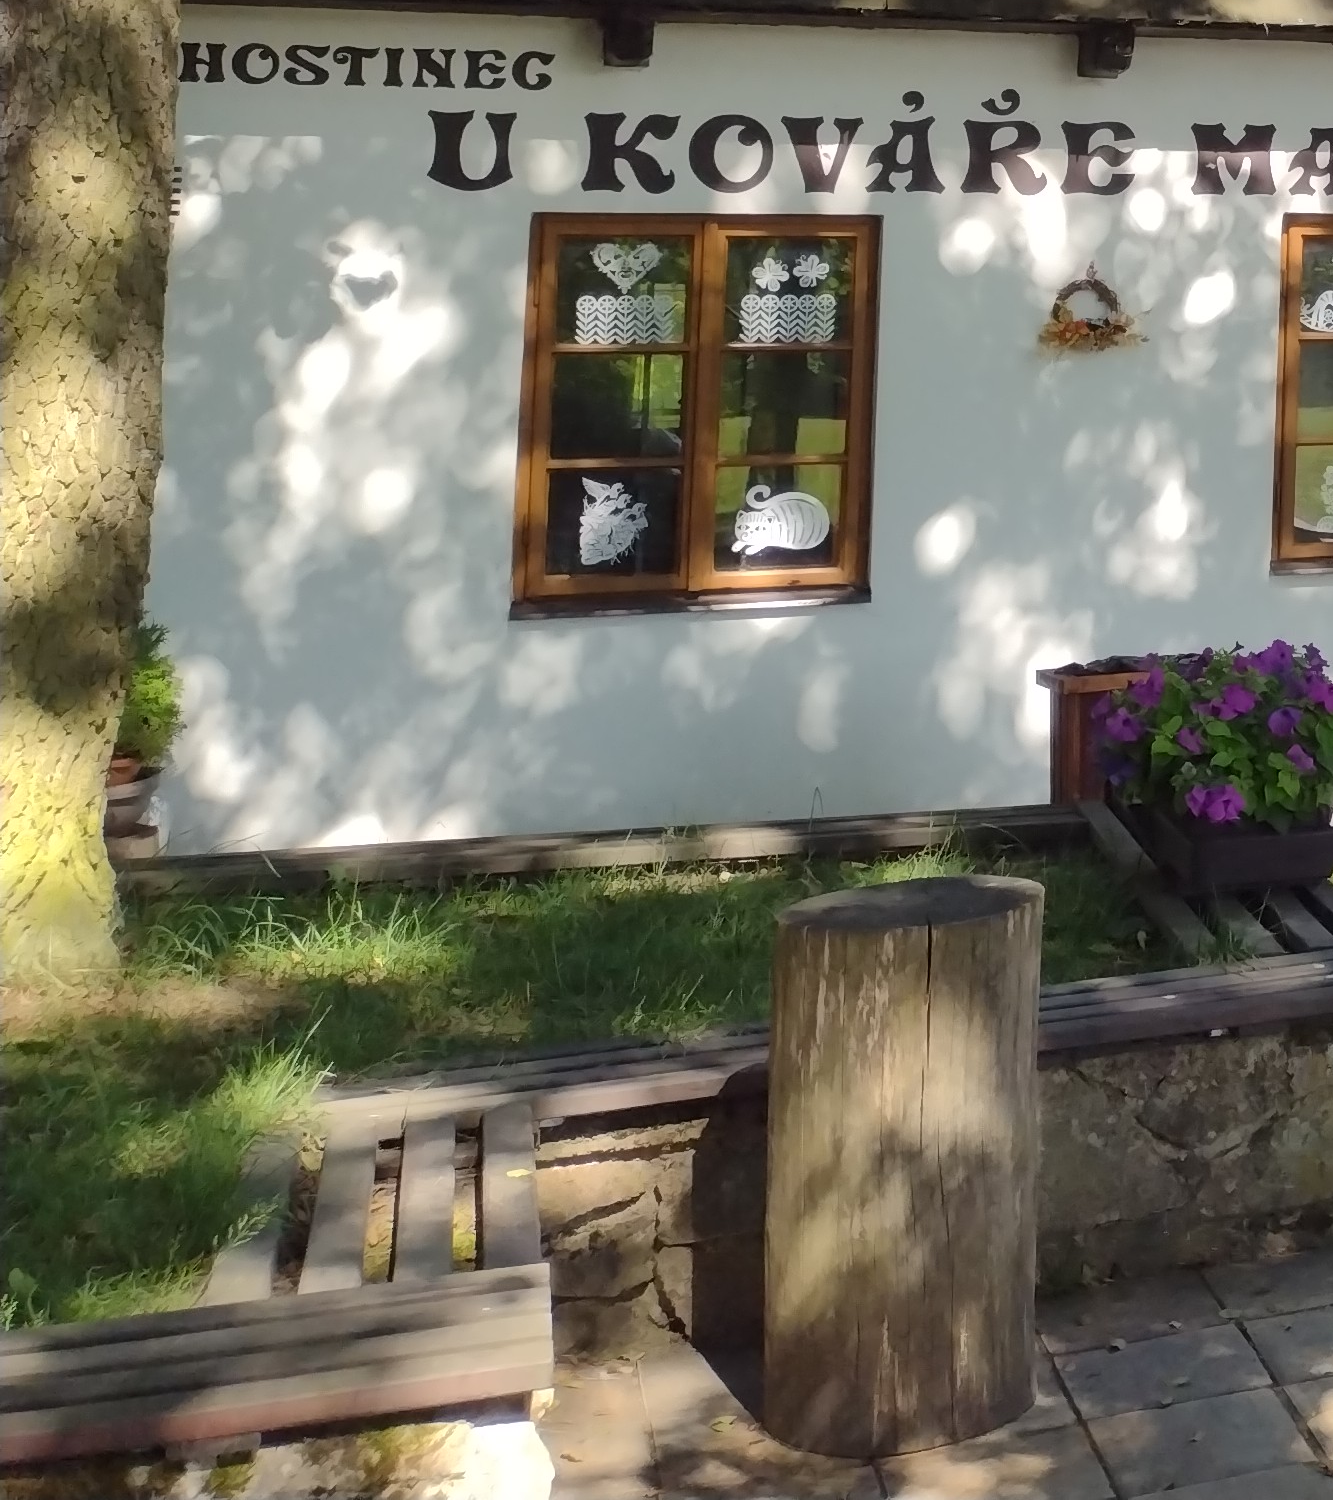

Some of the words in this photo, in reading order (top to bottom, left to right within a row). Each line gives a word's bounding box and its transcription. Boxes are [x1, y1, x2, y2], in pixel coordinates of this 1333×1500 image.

[178, 41, 556, 91] HOSTINEC
[427, 110, 517, 192] U
[581, 89, 1137, 197] KOVÁŘE
